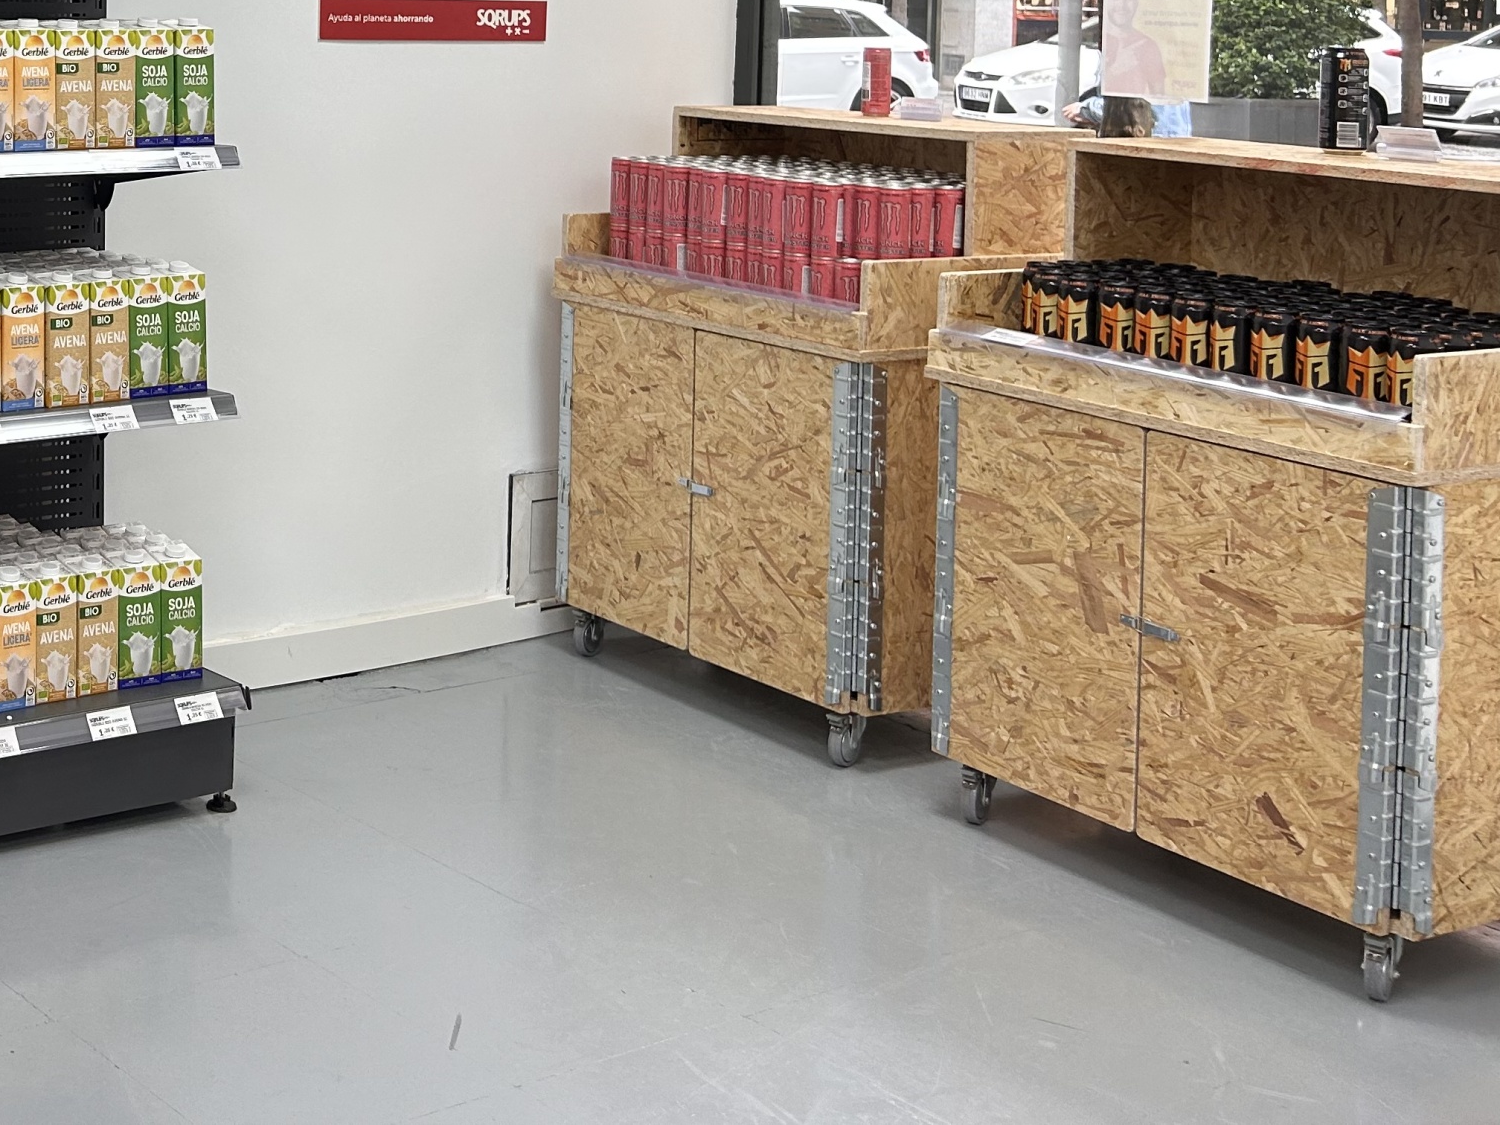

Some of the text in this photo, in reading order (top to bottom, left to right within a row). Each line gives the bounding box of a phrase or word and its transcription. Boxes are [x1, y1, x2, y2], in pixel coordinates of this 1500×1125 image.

[328, 13, 434, 24] Ayuda al planeta ahorrando
[476, 8, 531, 29] SQRUPS
[168, 577, 196, 589] Gerblé
[43, 593, 71, 607] Gerblé
[168, 596, 195, 611] SOJA
[42, 613, 57, 624] BIO
[169, 609, 196, 620] CALCIO
[40, 628, 74, 644] AVENA
